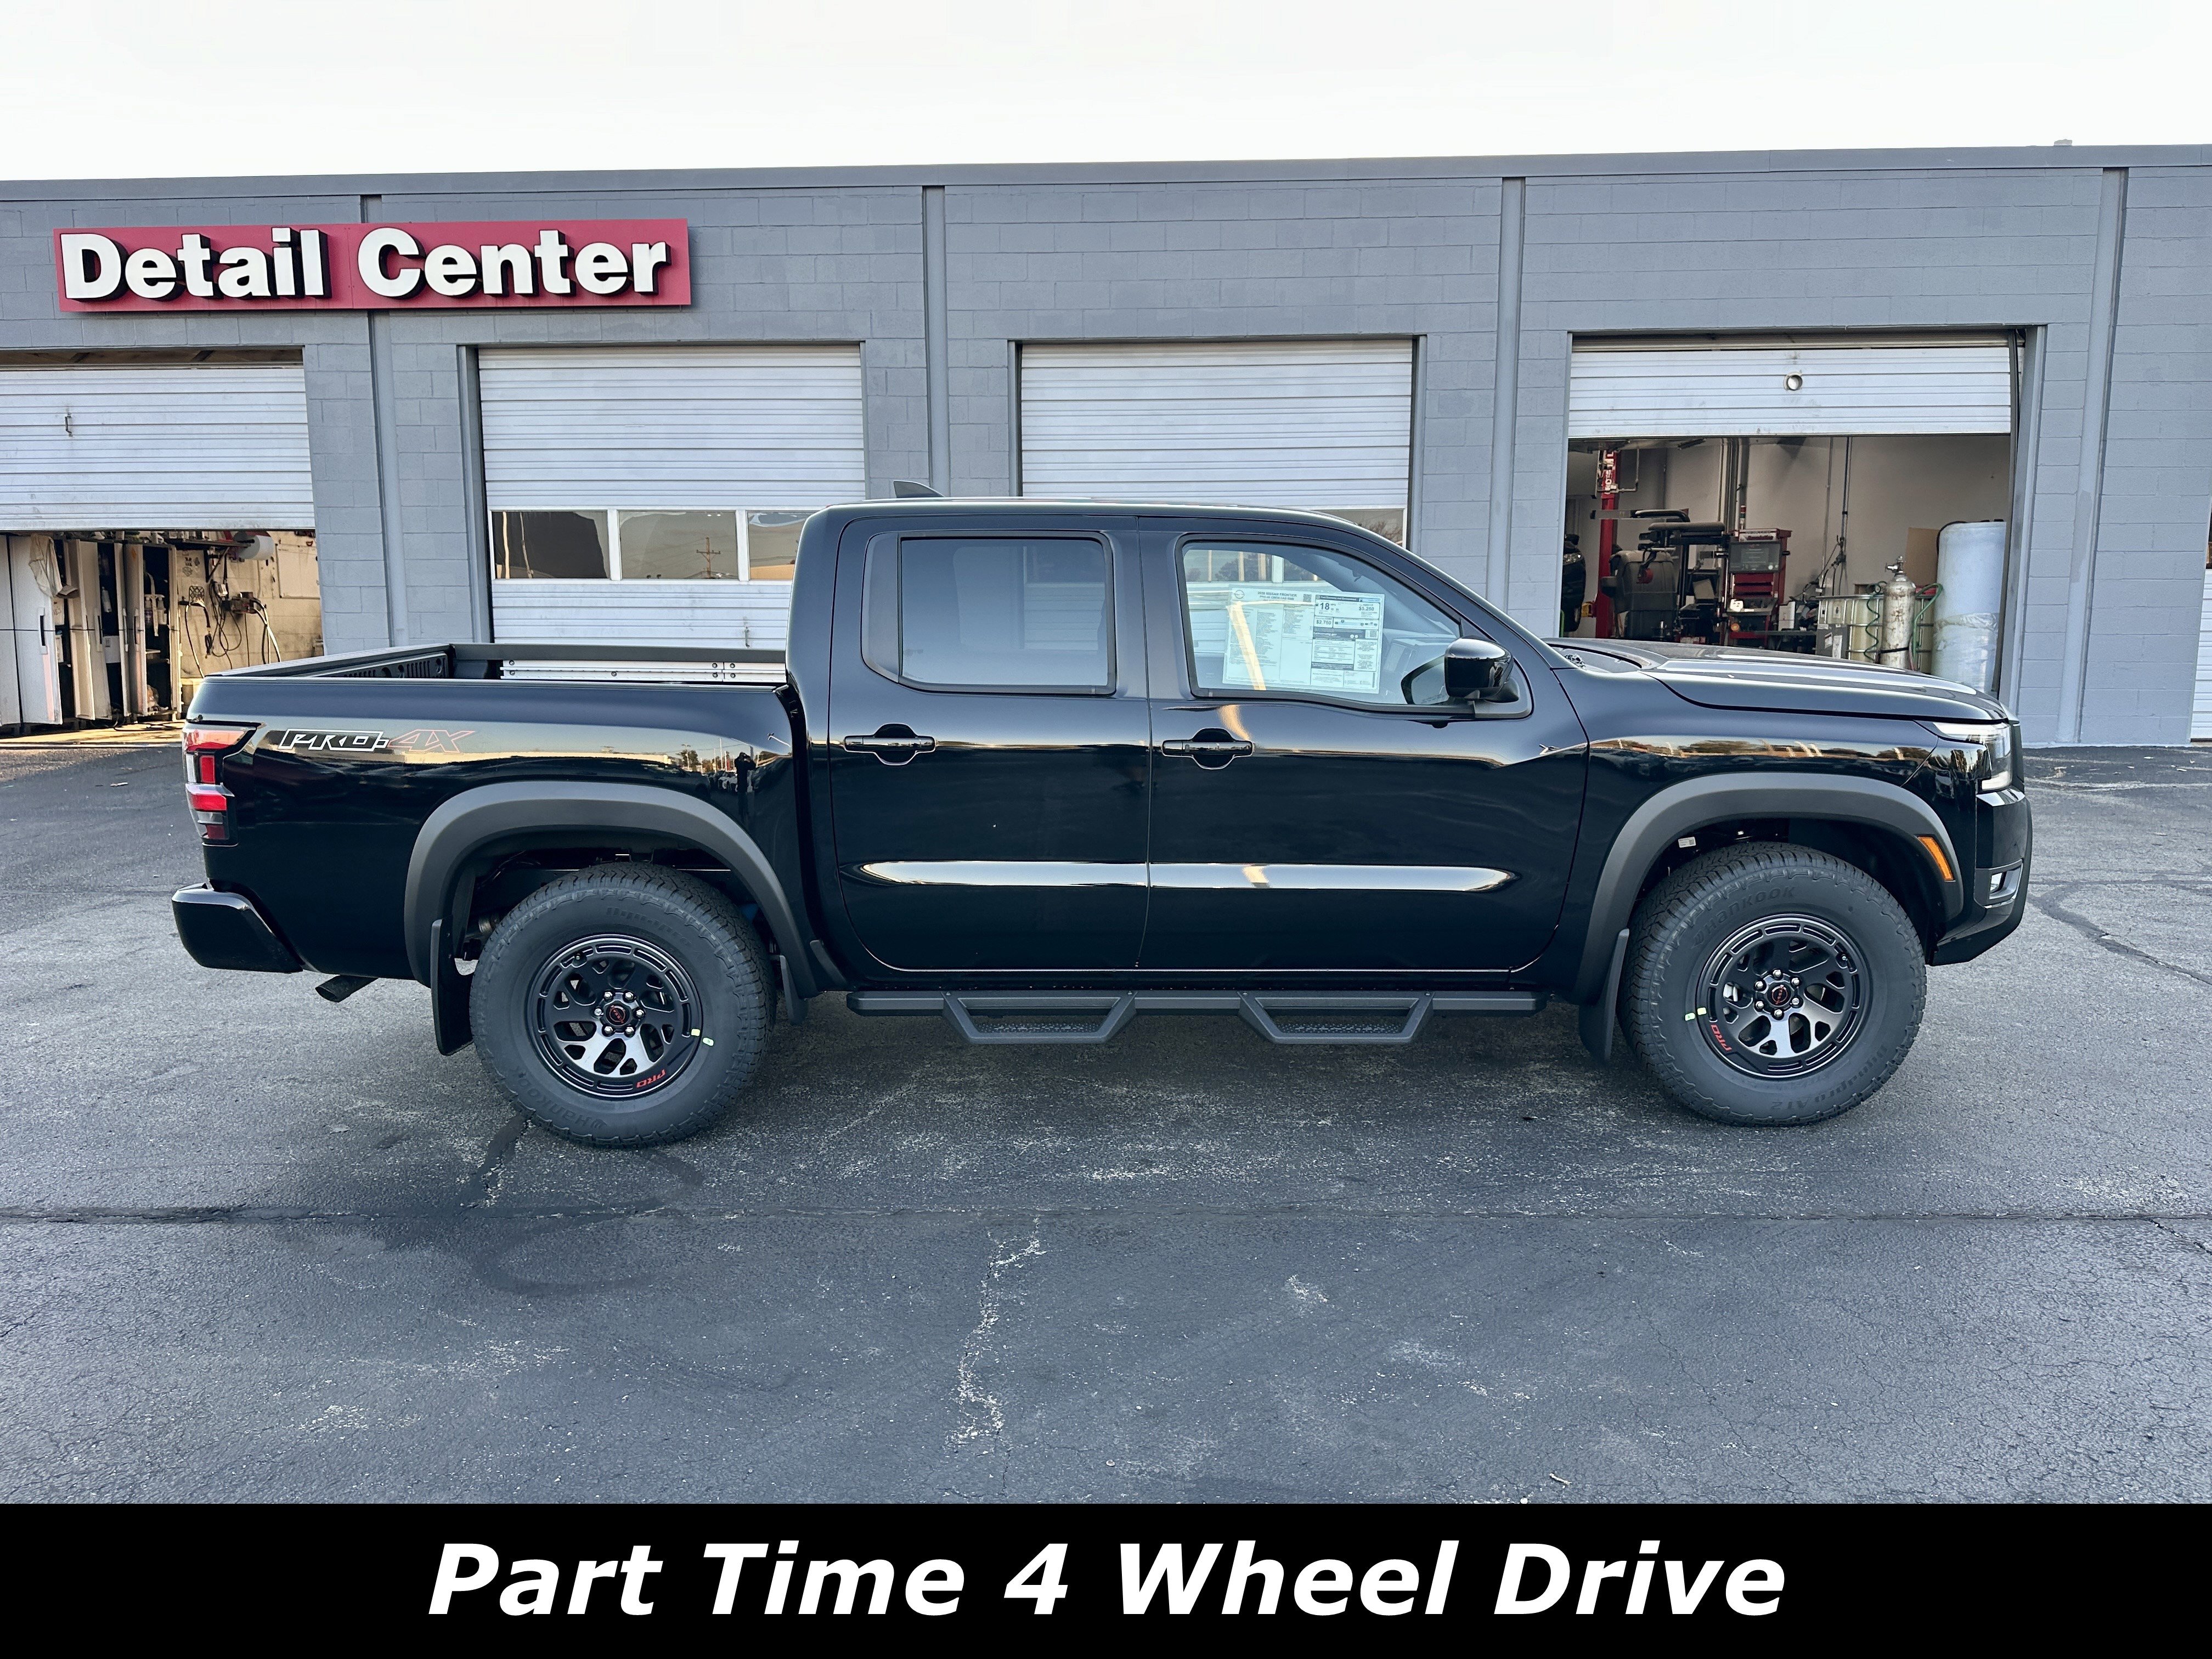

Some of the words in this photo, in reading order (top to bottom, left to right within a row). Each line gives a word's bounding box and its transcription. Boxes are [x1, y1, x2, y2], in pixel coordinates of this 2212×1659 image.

[61, 228, 325, 299] Detail
[358, 228, 667, 297] Center
[1711, 1024, 1733, 1052] PRO
[636, 1069, 666, 1088] PRO
